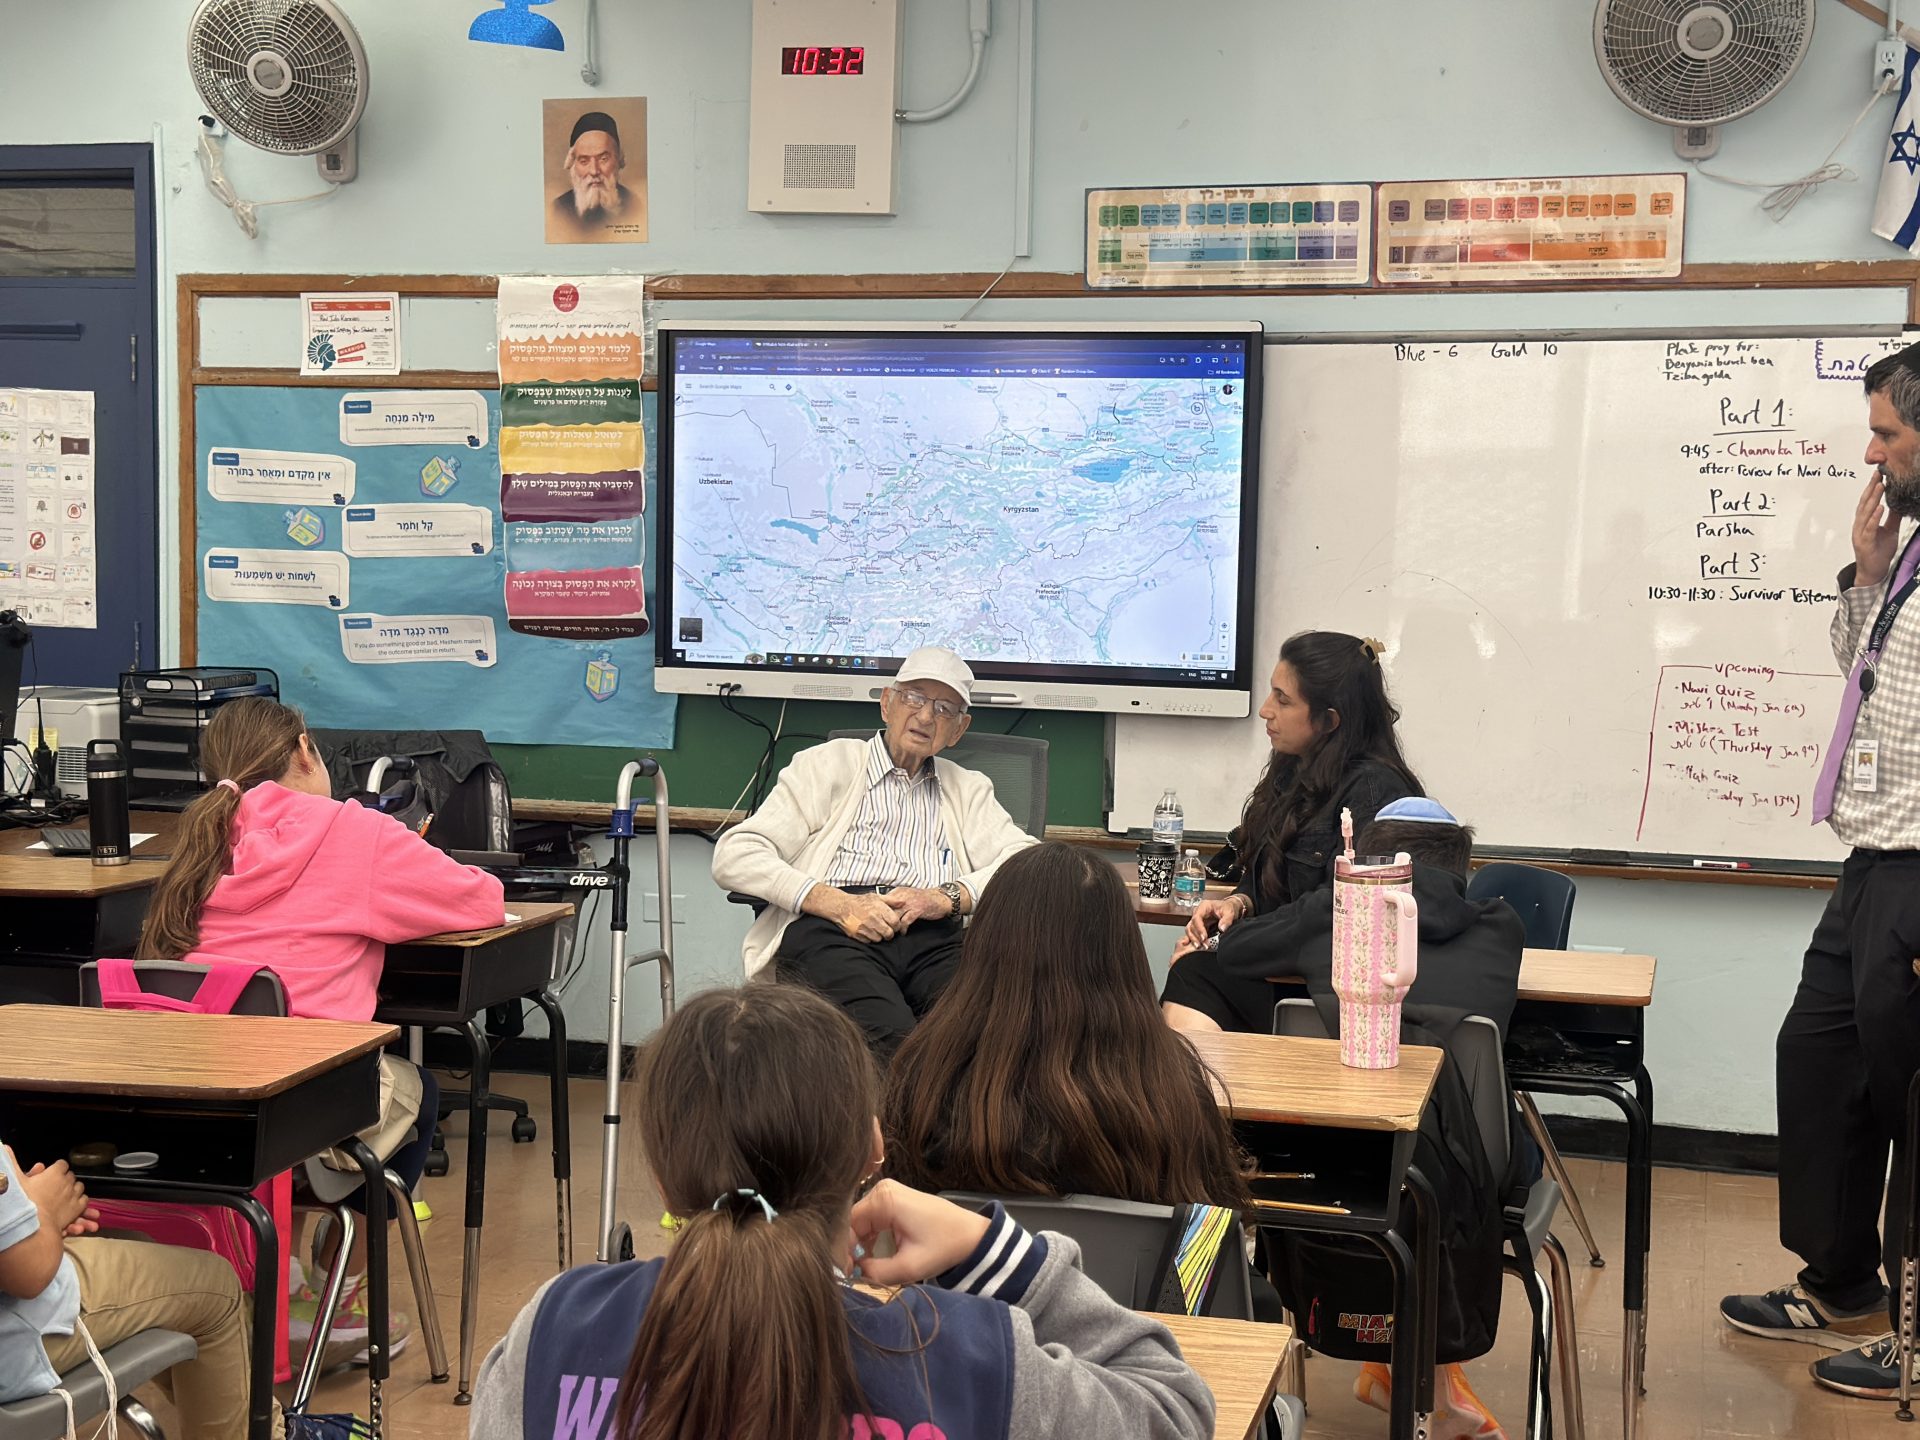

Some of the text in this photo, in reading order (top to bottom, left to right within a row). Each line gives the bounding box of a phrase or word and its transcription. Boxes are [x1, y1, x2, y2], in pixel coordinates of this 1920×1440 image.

[793, 48, 864, 74] 10:32
[1394, 343, 1426, 361] Blue
[1491, 343, 1528, 358] Gold
[1543, 343, 1558, 356] 10
[1719, 397, 1760, 426] Part
[1680, 444, 1710, 458] 9:45
[1795, 439, 1828, 456] Test
[1777, 463, 1792, 476] for
[1797, 464, 1821, 478] Navi
[1827, 465, 1856, 478] Quiz
[1709, 488, 1750, 514] Part
[1003, 506, 1040, 514] Kyrgyzstan
[1696, 522, 1755, 538] Parsha
[1700, 552, 1739, 578] Part
[1729, 585, 1786, 601] Survivor
[900, 620, 931, 628] Tajikistan
[1715, 684, 1756, 700] Quiz
[1762, 702, 1780, 712] Jan
[1732, 722, 1760, 737] Test
[1780, 745, 1799, 759] Jan
[569, 873, 609, 887] drive
[1783, 1303, 1819, 1328] N
